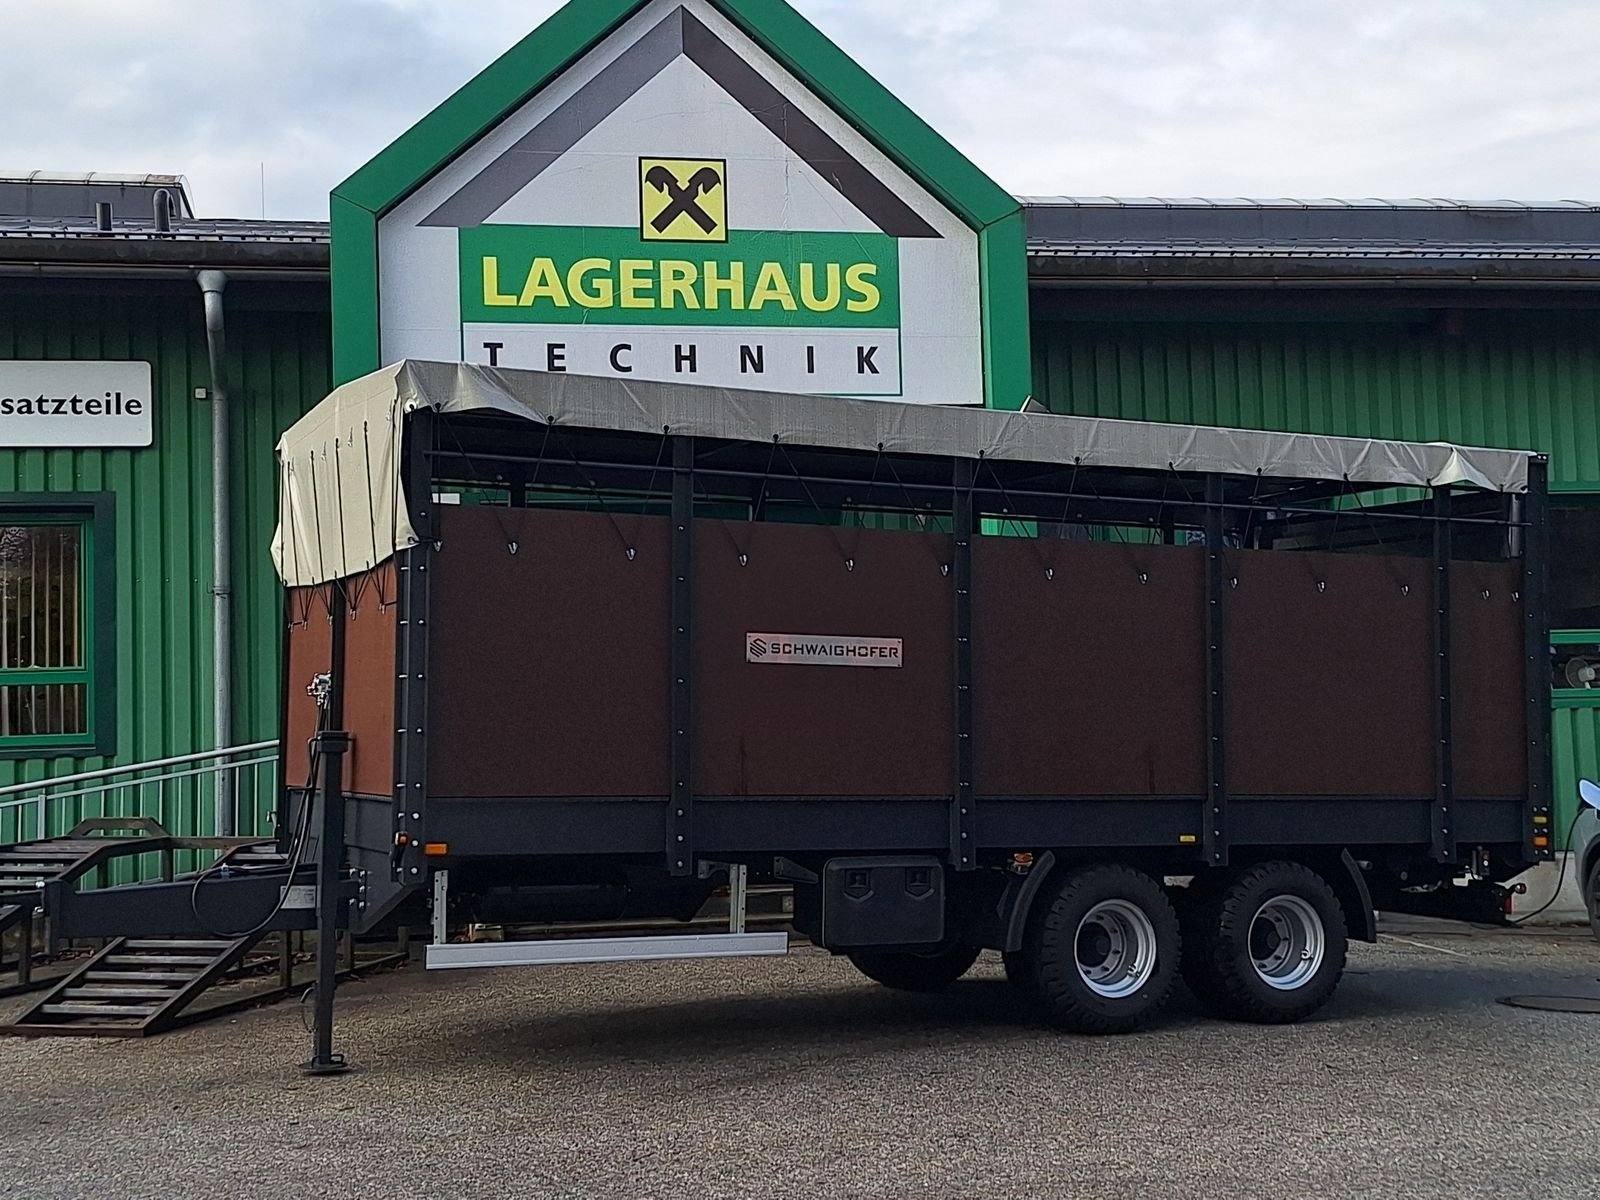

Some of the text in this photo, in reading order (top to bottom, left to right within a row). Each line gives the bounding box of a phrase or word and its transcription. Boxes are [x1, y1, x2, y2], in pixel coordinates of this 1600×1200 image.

[482, 256, 880, 312] LAGERHAUS
[483, 342, 879, 374] TECHNIK
[0, 392, 142, 415] satzteile
[771, 643, 898, 658] SCHWAIGHOFER
